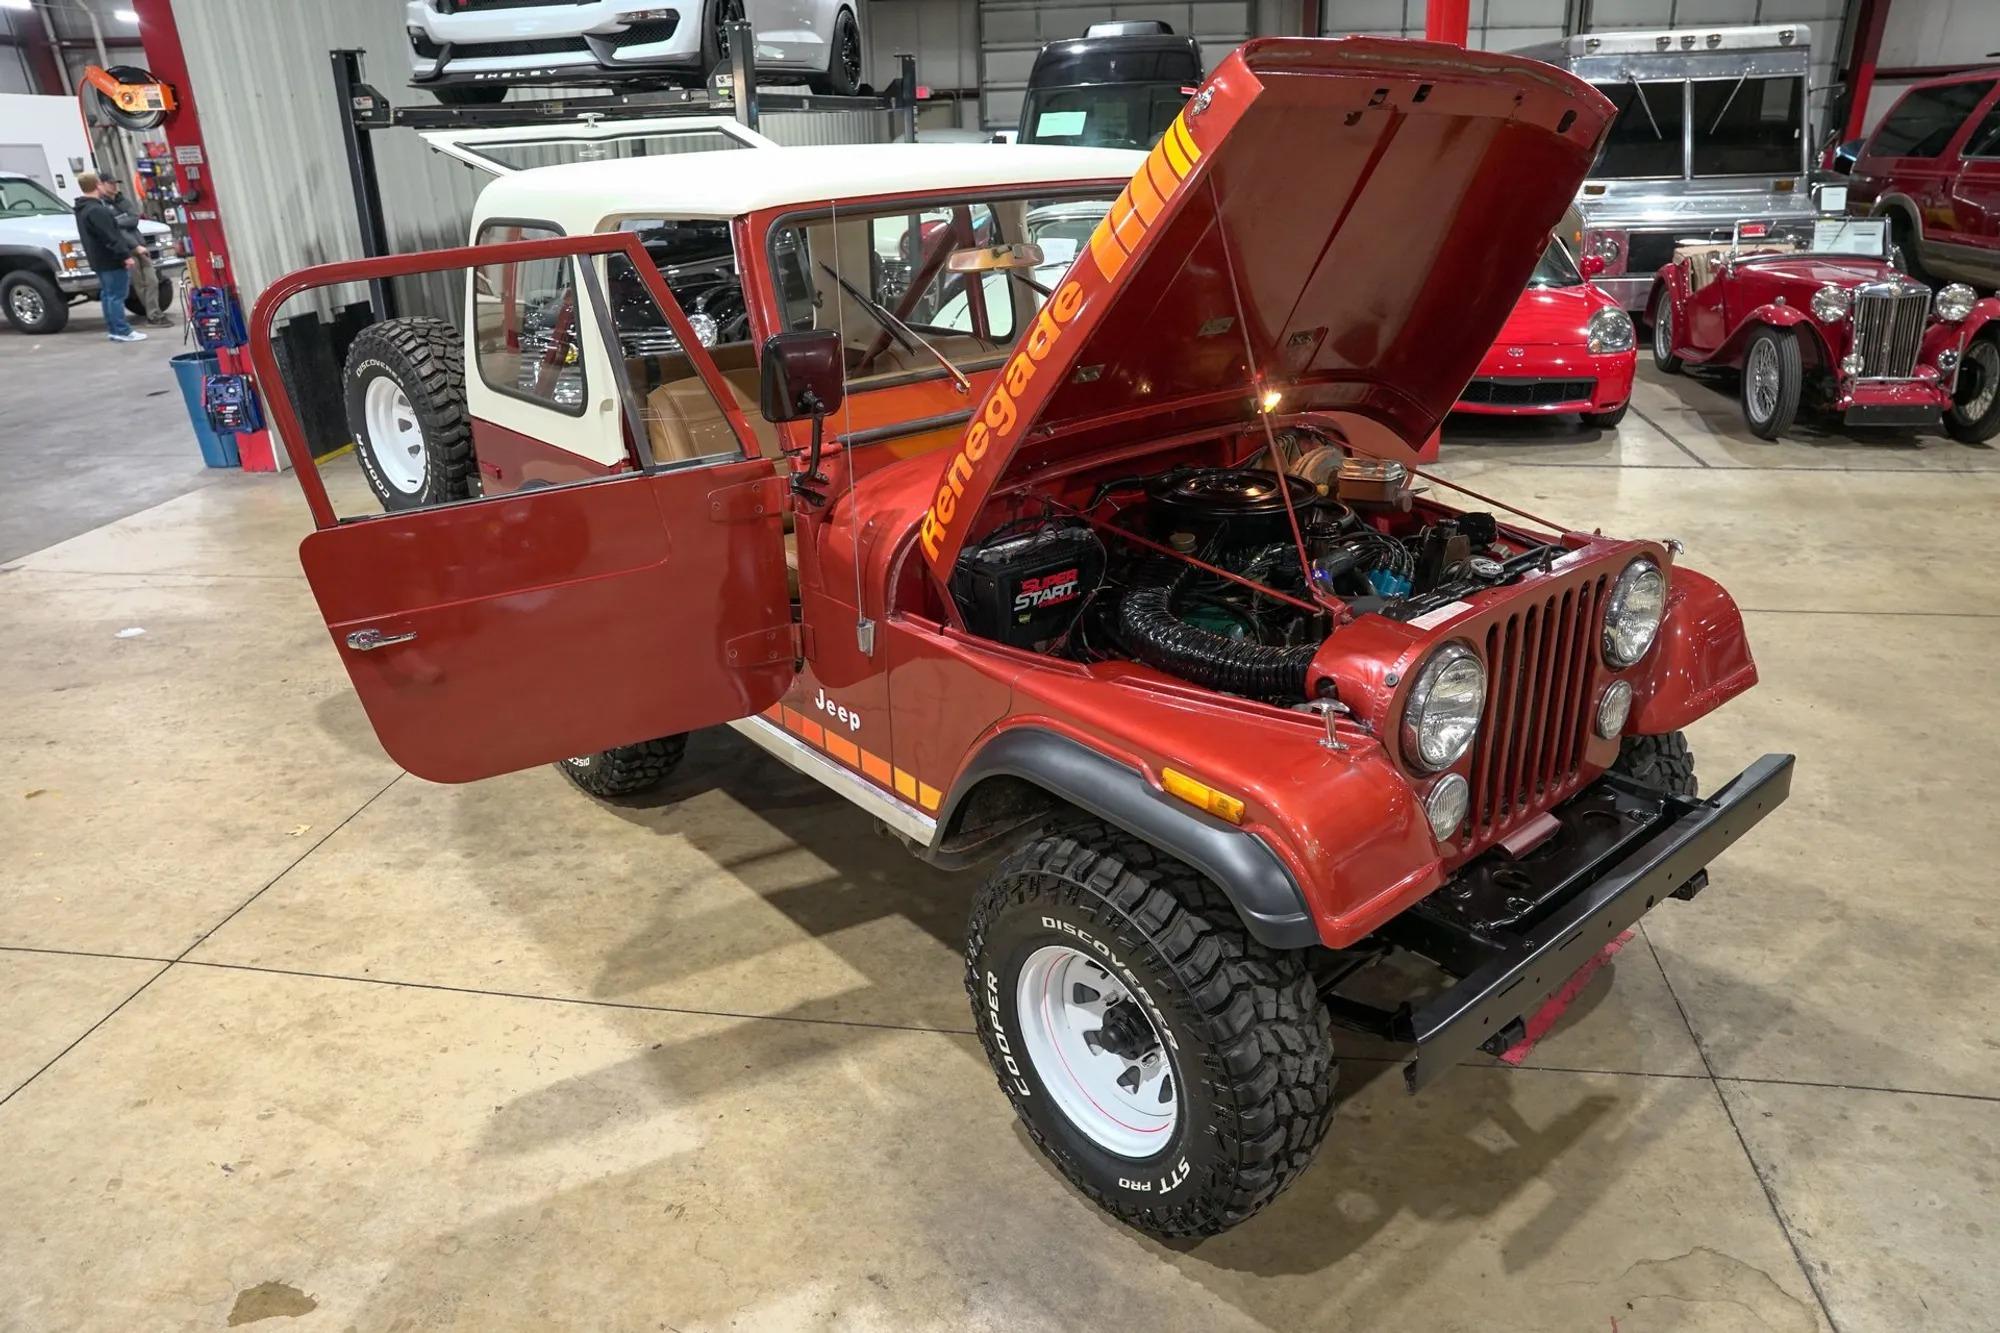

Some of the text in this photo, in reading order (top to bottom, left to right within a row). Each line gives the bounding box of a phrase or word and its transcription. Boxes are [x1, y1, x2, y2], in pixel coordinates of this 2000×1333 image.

[474, 69, 557, 80] SHELBY
[356, 358, 404, 387] DISCOVERER
[920, 280, 1084, 563] Renegade
[356, 433, 390, 498] COOPER
[1013, 581, 1079, 612] START
[1021, 568, 1079, 595] SUPER
[814, 688, 861, 731] Jeep
[1041, 916, 1179, 1051] DISCOVERER
[987, 970, 1032, 1096] COOPER
[1118, 1155, 1191, 1195] STT PRO
